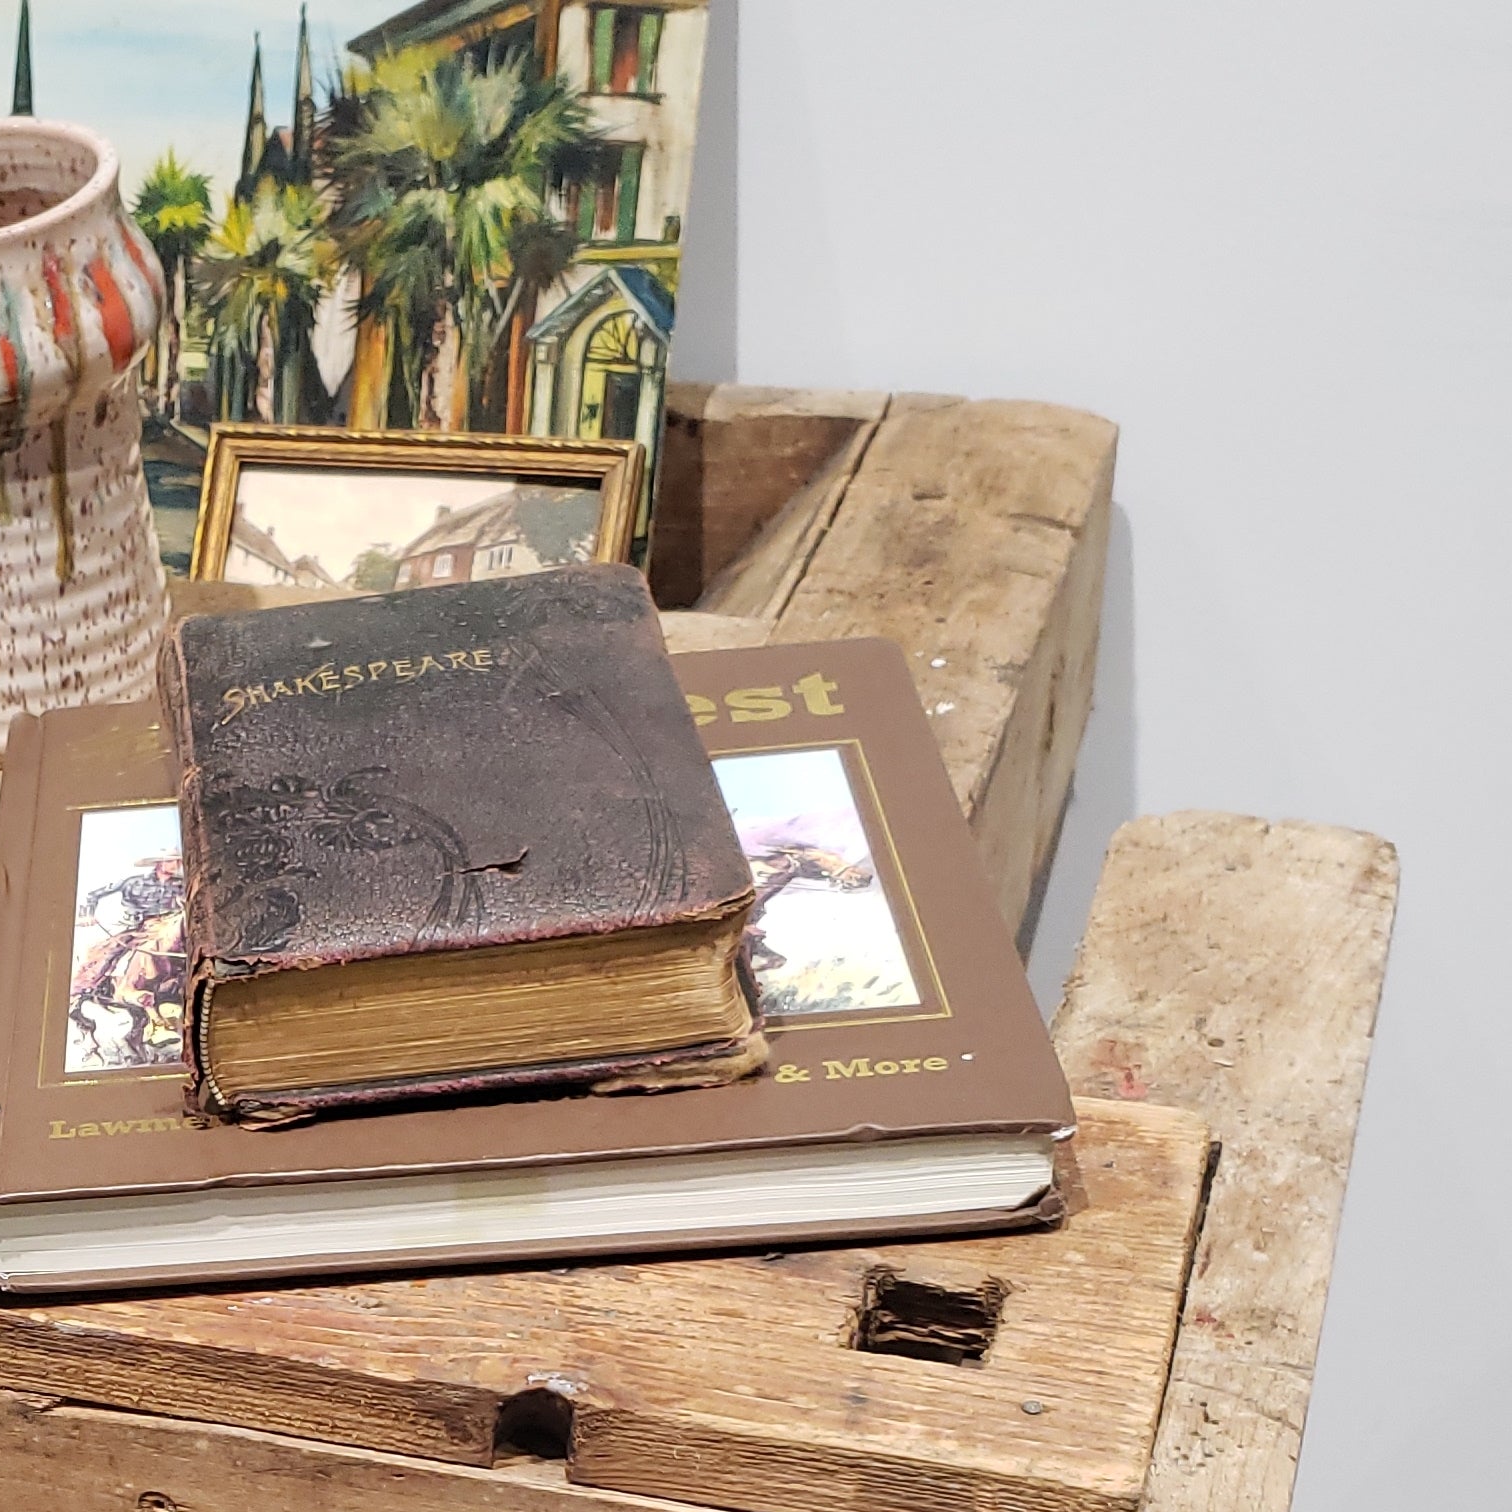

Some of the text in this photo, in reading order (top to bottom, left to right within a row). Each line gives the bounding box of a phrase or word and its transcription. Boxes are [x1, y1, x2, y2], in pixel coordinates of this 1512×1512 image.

[222, 649, 493, 726] SHAKESPEARE
[47, 1056, 949, 1140] Lawme & More
